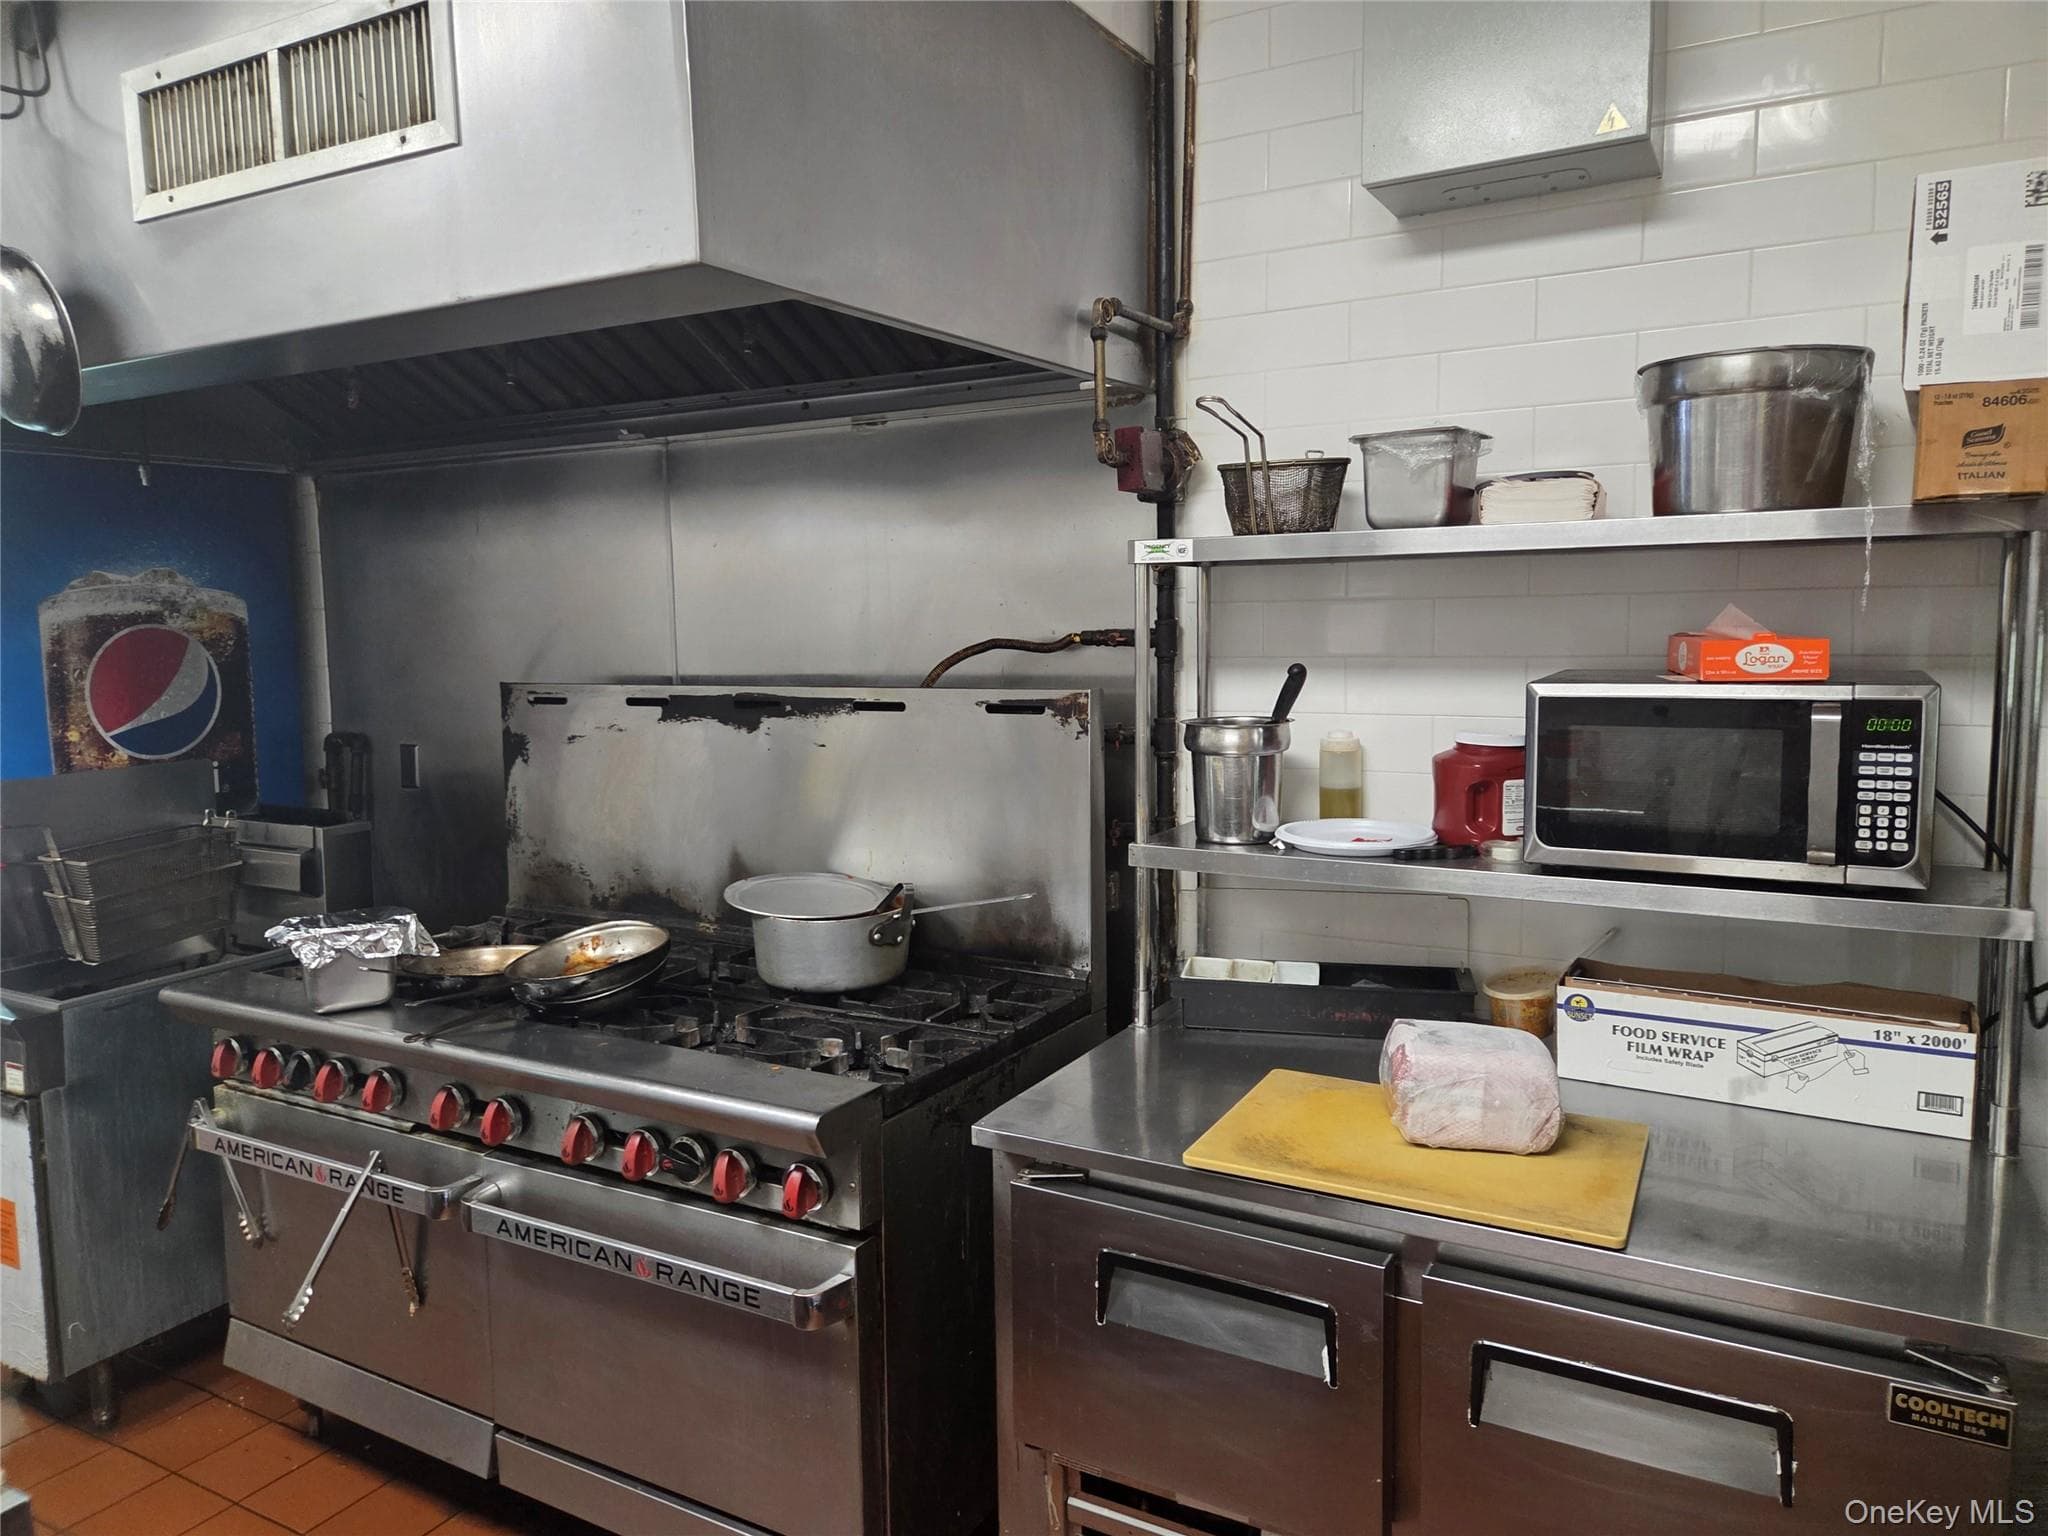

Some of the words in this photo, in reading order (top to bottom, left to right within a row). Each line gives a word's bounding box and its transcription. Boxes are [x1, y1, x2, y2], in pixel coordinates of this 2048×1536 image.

[1934, 181, 1951, 229] 32565
[1925, 359, 1934, 376] TOTAL
[1982, 394, 2027, 408] 84606
[1957, 471, 2006, 480] ITALIAN
[1743, 651, 1788, 666] Logan
[1866, 718, 1912, 732] 00:00
[1612, 1024, 1658, 1041] FOOD
[1661, 1031, 1728, 1050] SERVICE
[1873, 1029, 1901, 1042] 18"
[1907, 1035, 1916, 1045] x
[1921, 1034, 1968, 1050] 2000'
[1627, 1041, 1663, 1056] FILM
[1667, 1046, 1715, 1062] WRAP
[1636, 1054, 1663, 1063] Includes
[1664, 1058, 1684, 1067] Safety
[1685, 1061, 1705, 1069] Blade
[214, 1137, 314, 1178] AMERICAN
[329, 1168, 405, 1204] RANGE
[496, 1218, 633, 1273] AMERICAN
[655, 1262, 761, 1310] RANGE
[1895, 1393, 2007, 1431] COOLTECH
[1911, 1413, 1944, 1427] MADE
[1947, 1421, 1959, 1430] IN
[1963, 1425, 1986, 1437] USA
